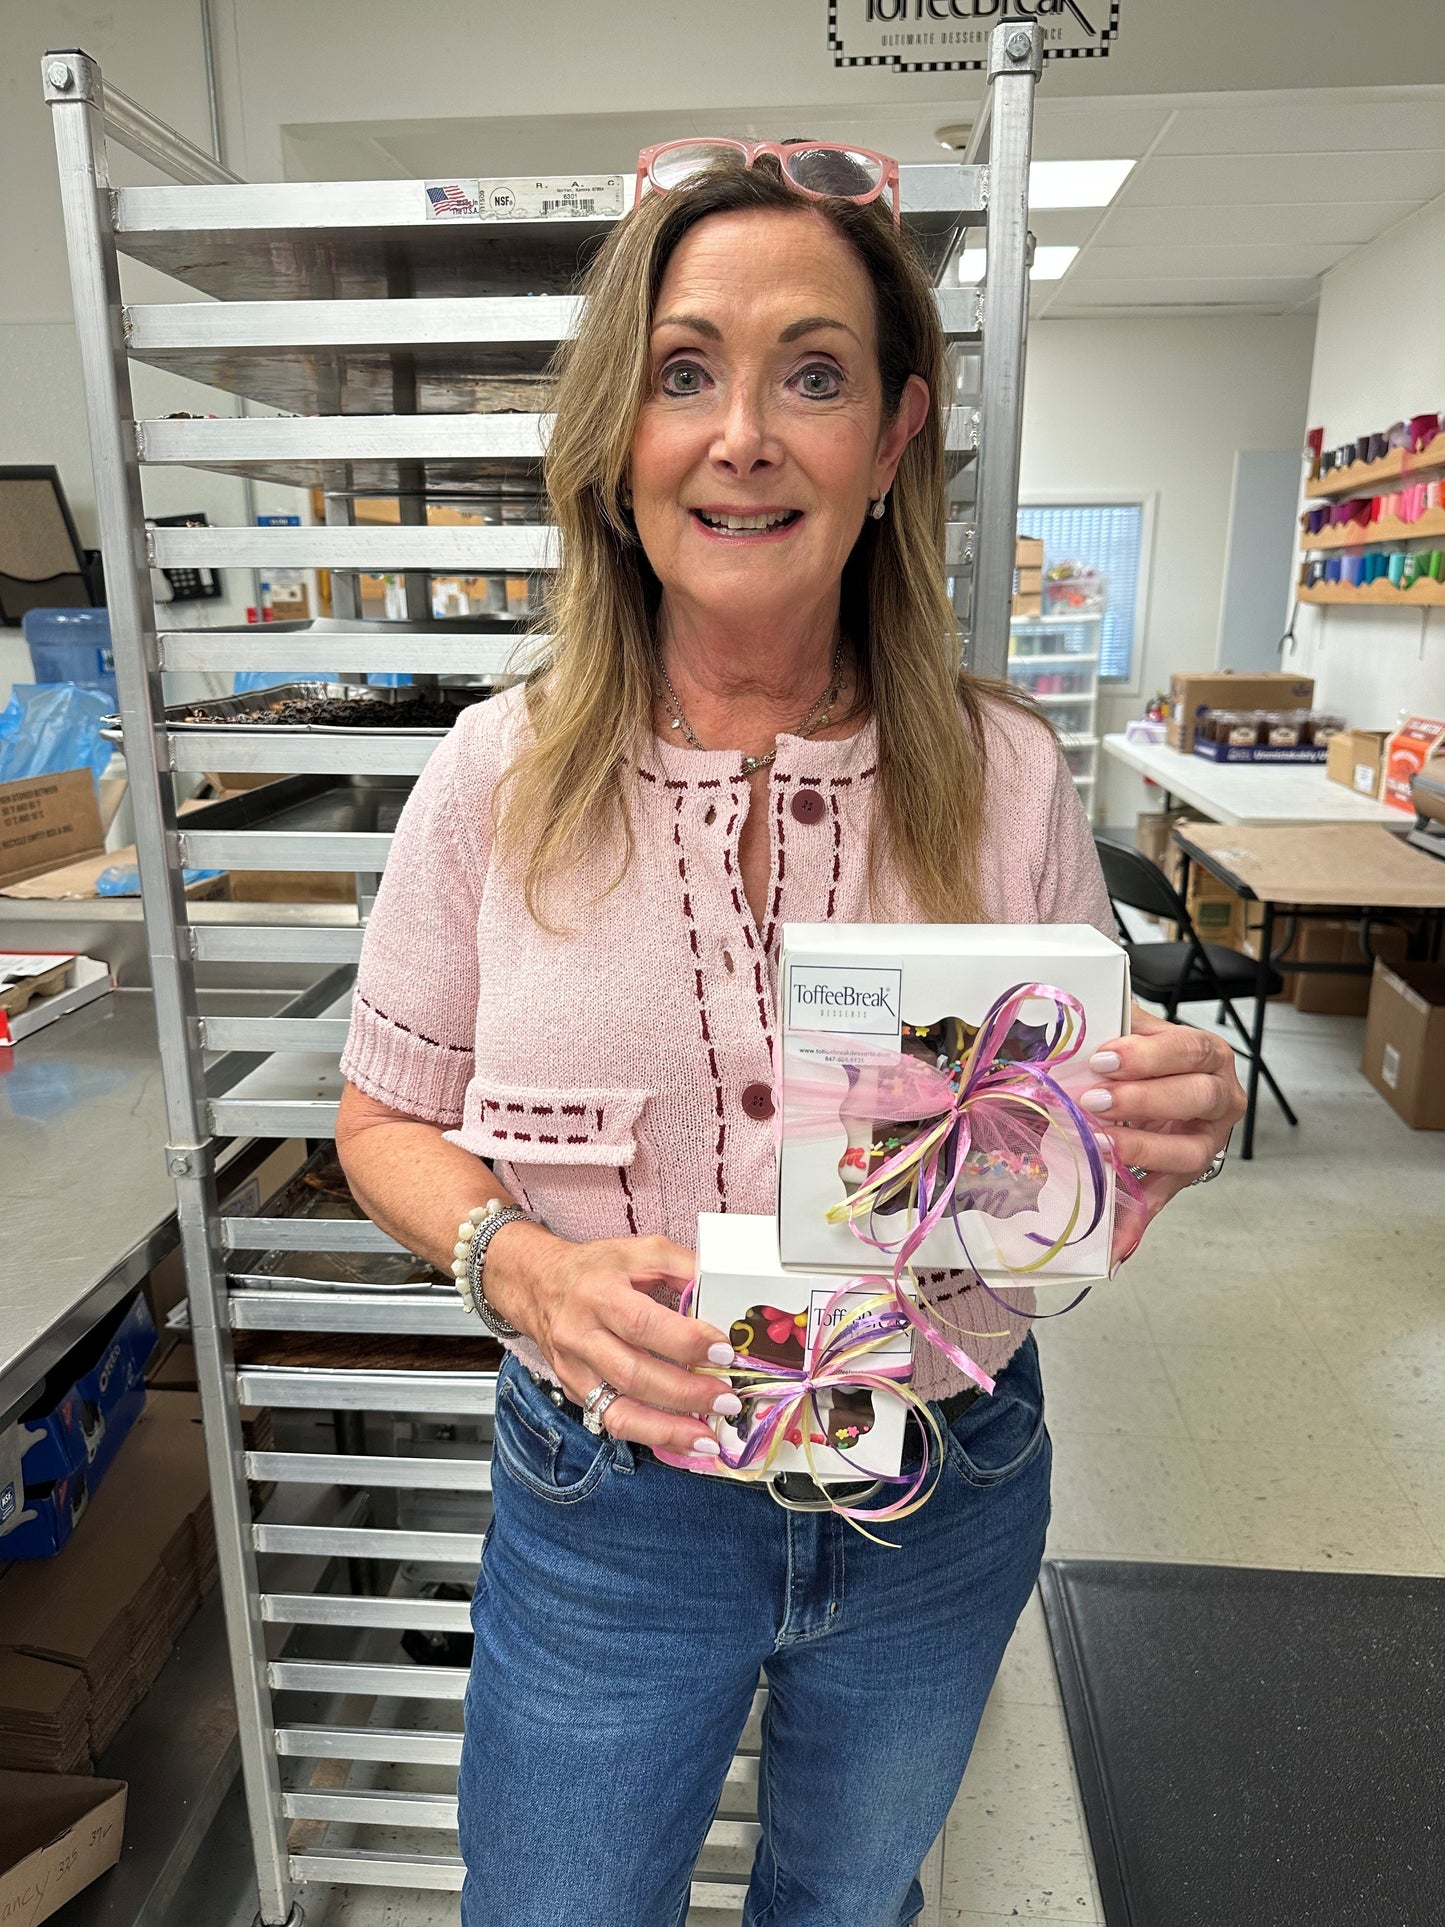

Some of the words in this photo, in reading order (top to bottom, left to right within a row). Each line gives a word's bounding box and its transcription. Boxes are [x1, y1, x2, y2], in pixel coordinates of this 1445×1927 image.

[881, 33, 935, 46] ULTIMATE
[494, 195, 510, 206] NSF
[793, 984, 896, 1017] ToffeeBreak
